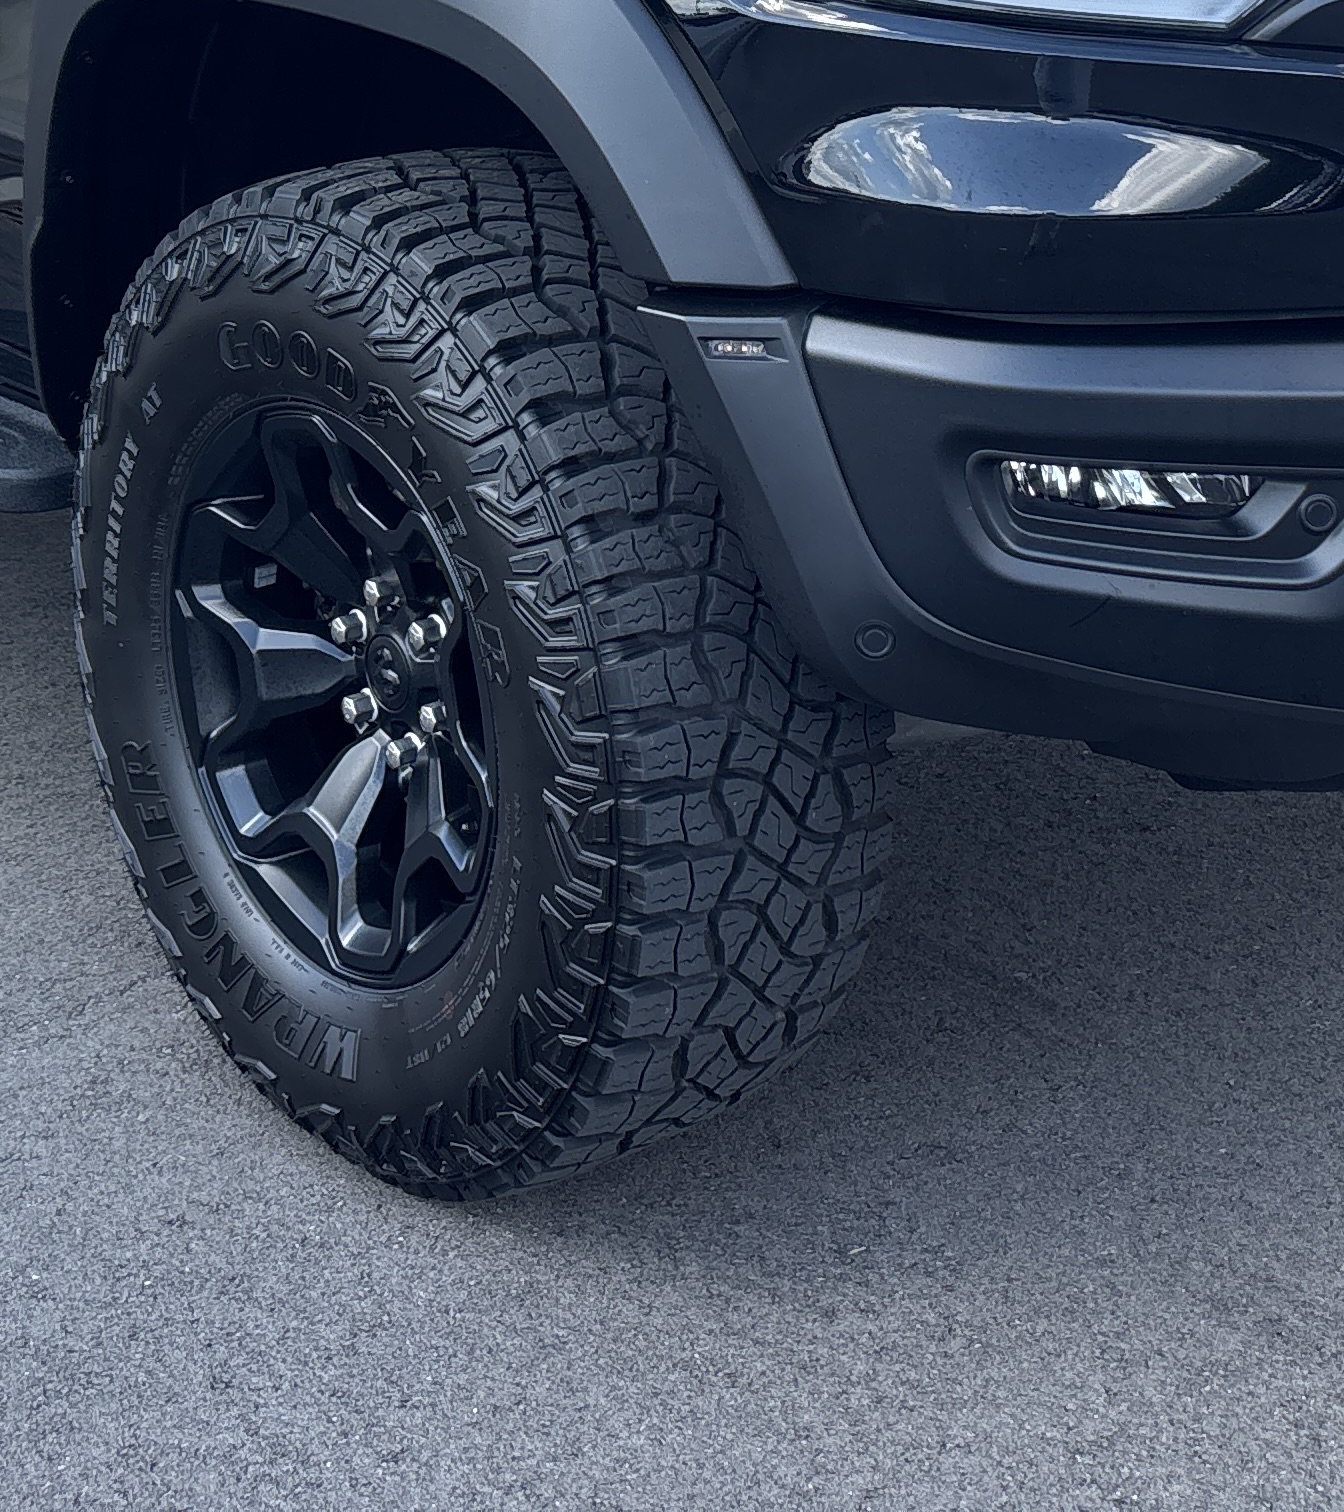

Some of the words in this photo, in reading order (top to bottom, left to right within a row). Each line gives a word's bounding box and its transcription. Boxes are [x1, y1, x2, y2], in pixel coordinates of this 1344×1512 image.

[102, 429, 140, 627] TERRITORY
[140, 381, 163, 426] AT
[120, 740, 361, 1083] WRANGLER
